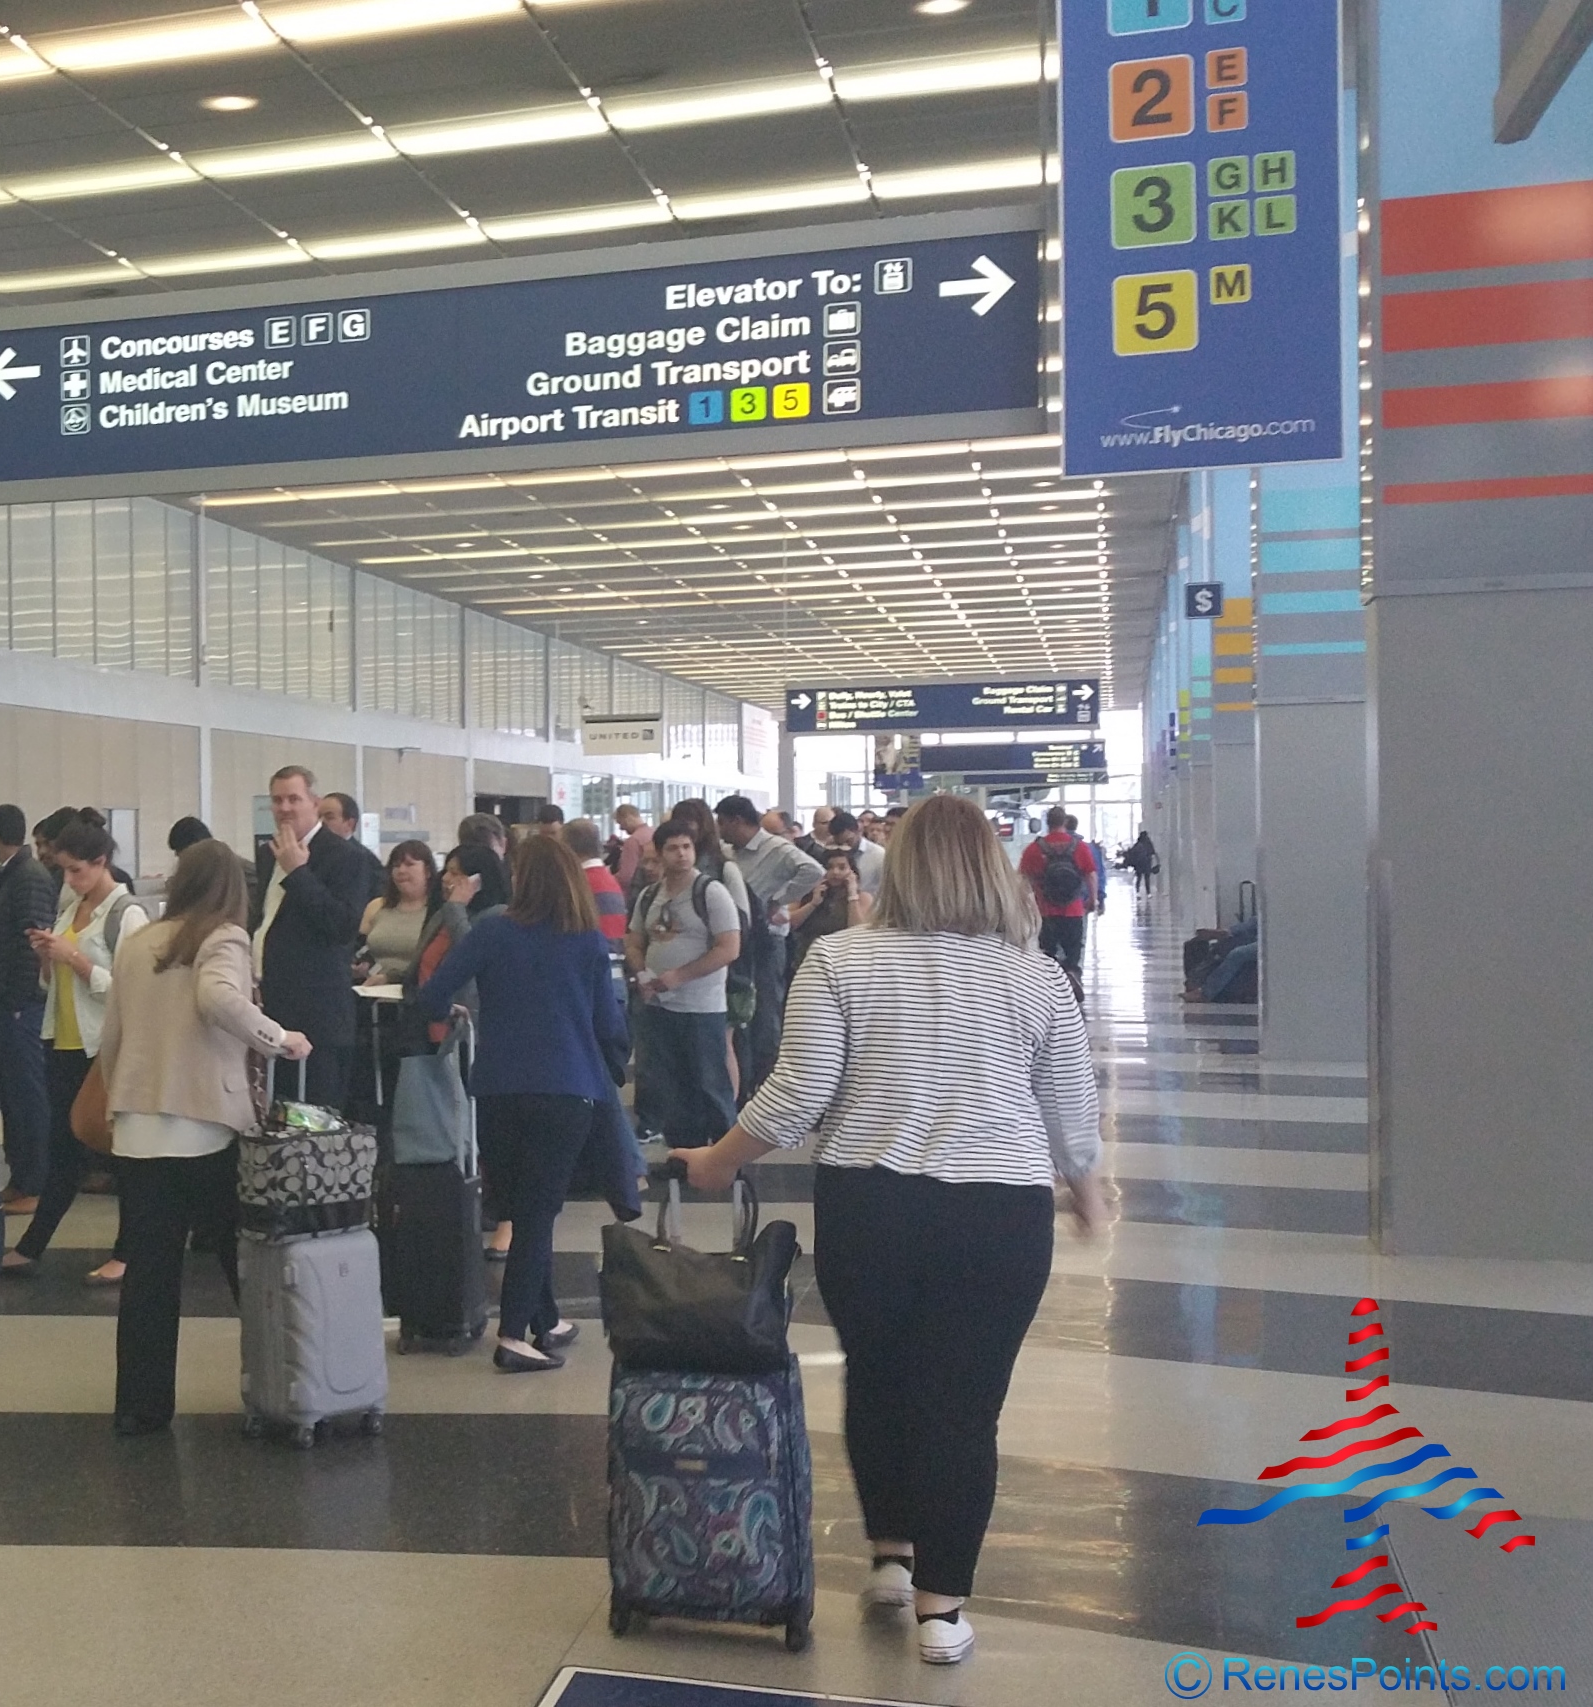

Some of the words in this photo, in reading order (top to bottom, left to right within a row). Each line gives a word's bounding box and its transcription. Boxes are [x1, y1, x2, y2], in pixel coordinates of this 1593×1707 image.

[1131, 69, 1172, 127] 2
[1217, 55, 1236, 82] E
[1218, 98, 1236, 125] F
[1132, 176, 1175, 234] 3
[1216, 163, 1241, 189] G
[1262, 157, 1287, 186] H
[1218, 206, 1242, 233] K
[1265, 201, 1285, 229] L
[665, 276, 802, 311] Elevator
[812, 269, 862, 296] To:
[1134, 283, 1176, 340] 5
[1216, 270, 1245, 298] M
[101, 326, 254, 361] Concourses
[271, 320, 290, 344] E
[309, 317, 326, 341] F
[342, 313, 366, 338] G
[564, 324, 705, 358] Baggage
[716, 315, 811, 344] Claim
[100, 361, 197, 395] Medical
[206, 356, 293, 386] Center
[526, 365, 642, 398] Ground
[650, 350, 811, 386] Transport
[100, 397, 228, 430] Children's
[238, 389, 349, 418] Museum
[459, 407, 564, 441] Airport
[573, 398, 680, 430] Transit
[700, 396, 713, 418] 1
[739, 392, 756, 415] 3
[781, 390, 799, 411] 5
[1101, 417, 1316, 448] www.FlyChicago.com
[589, 731, 639, 740] UNITED
